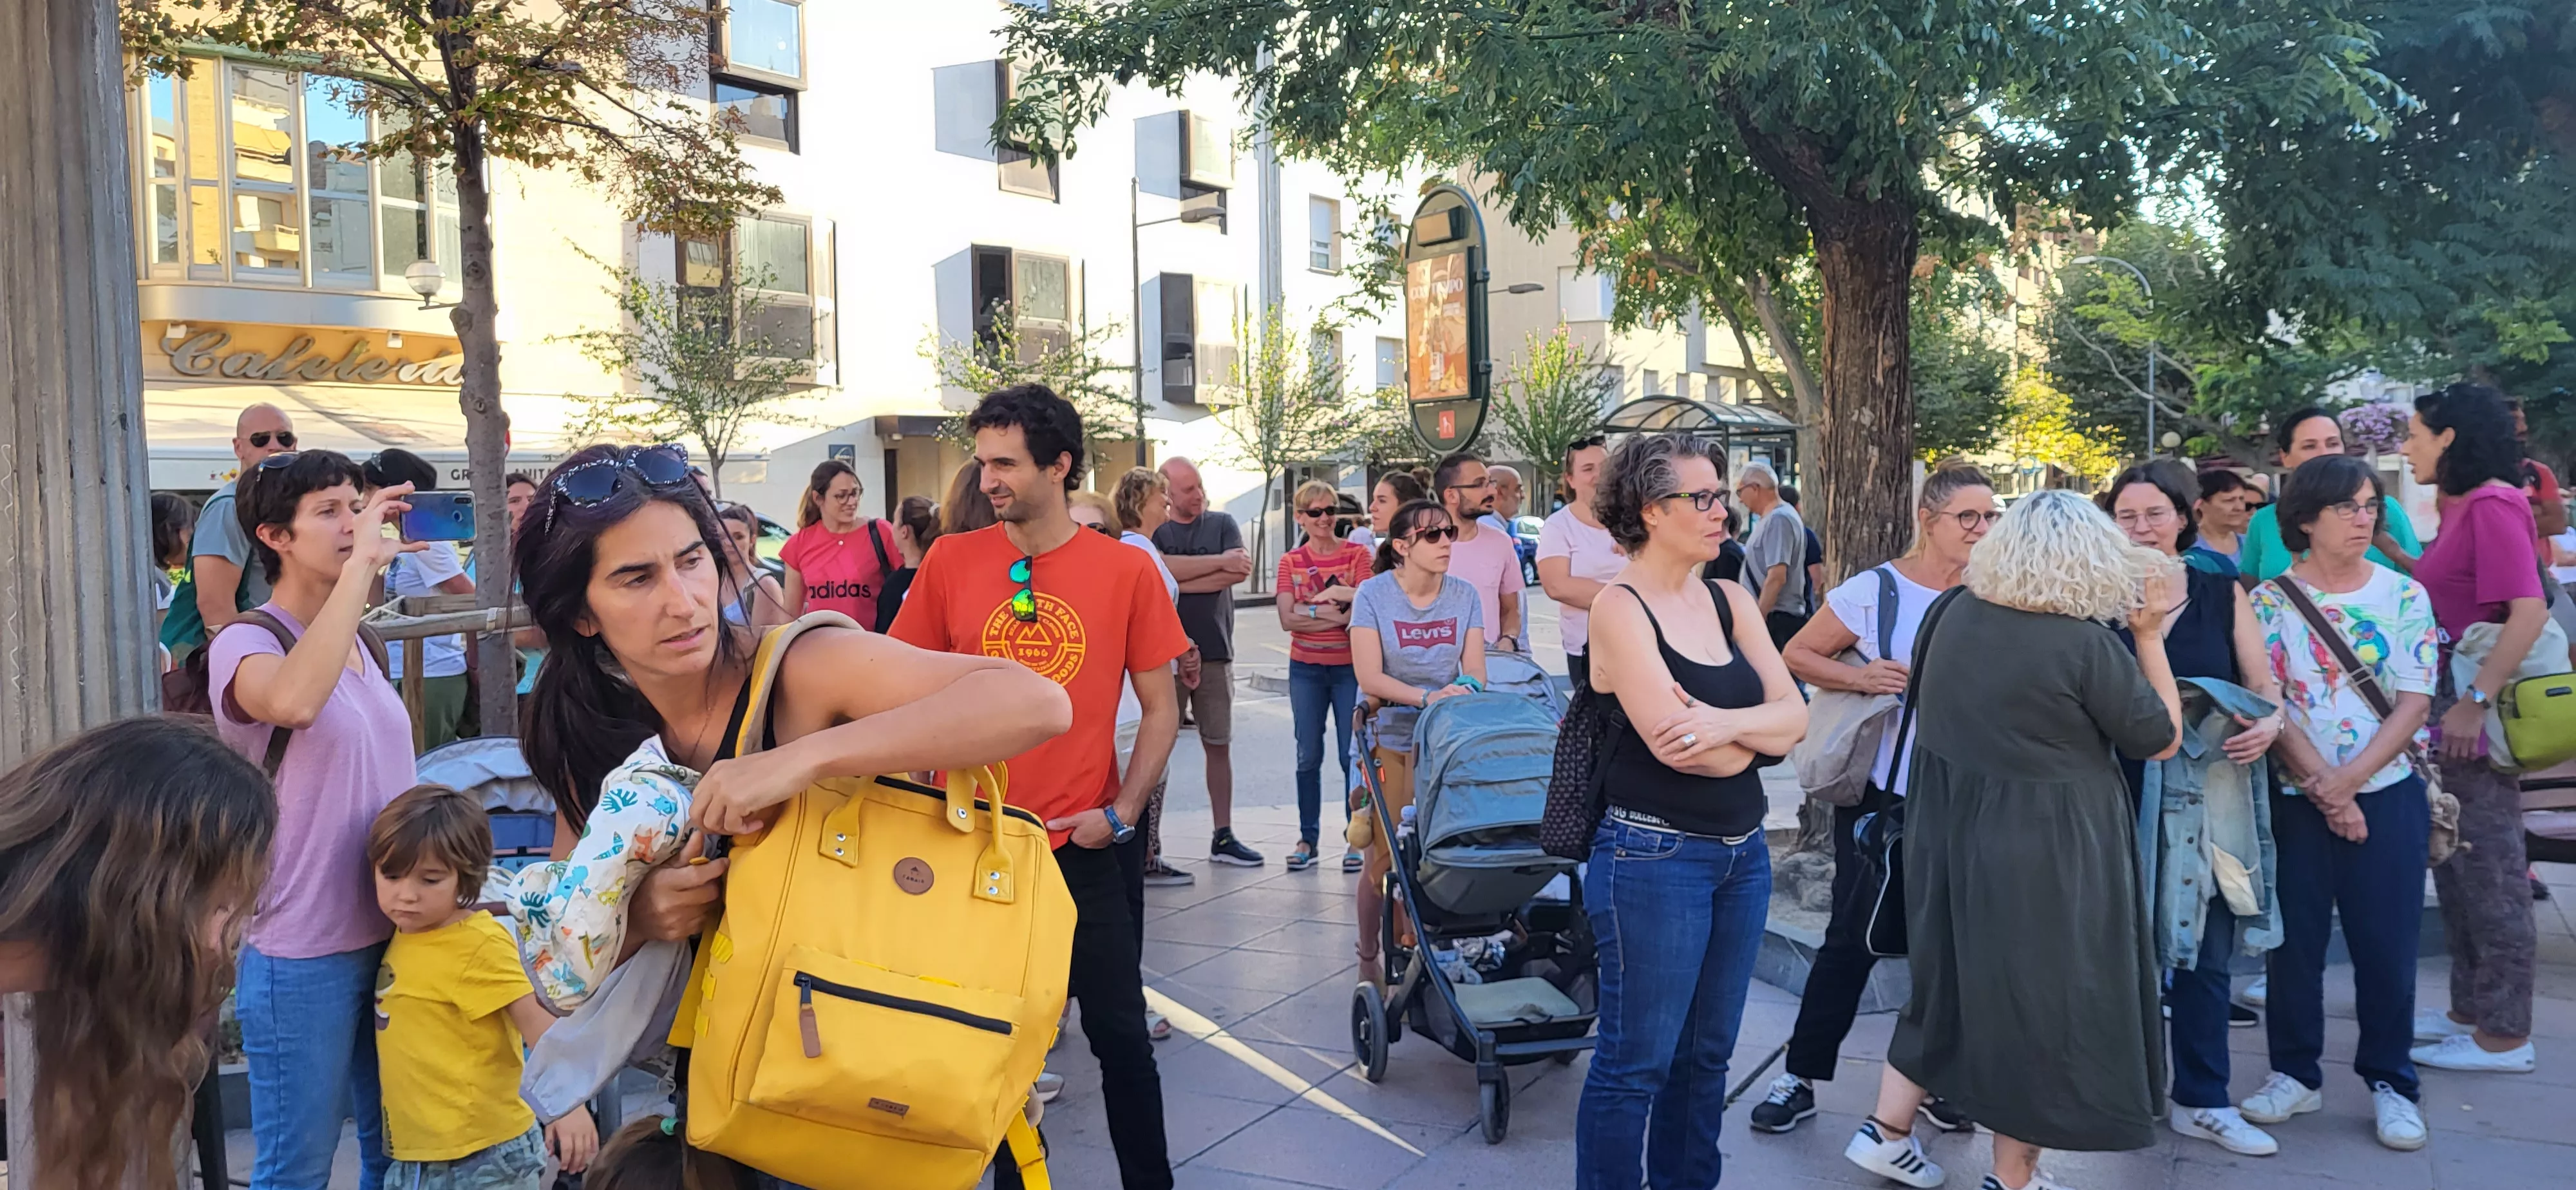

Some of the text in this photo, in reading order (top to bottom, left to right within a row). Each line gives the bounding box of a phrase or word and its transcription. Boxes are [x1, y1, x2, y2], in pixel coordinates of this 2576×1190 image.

[989, 610, 1009, 636] THE
[1055, 607, 1079, 639] FACE
[1018, 647, 1049, 658] 1966
[1051, 653, 1079, 683] OODS
